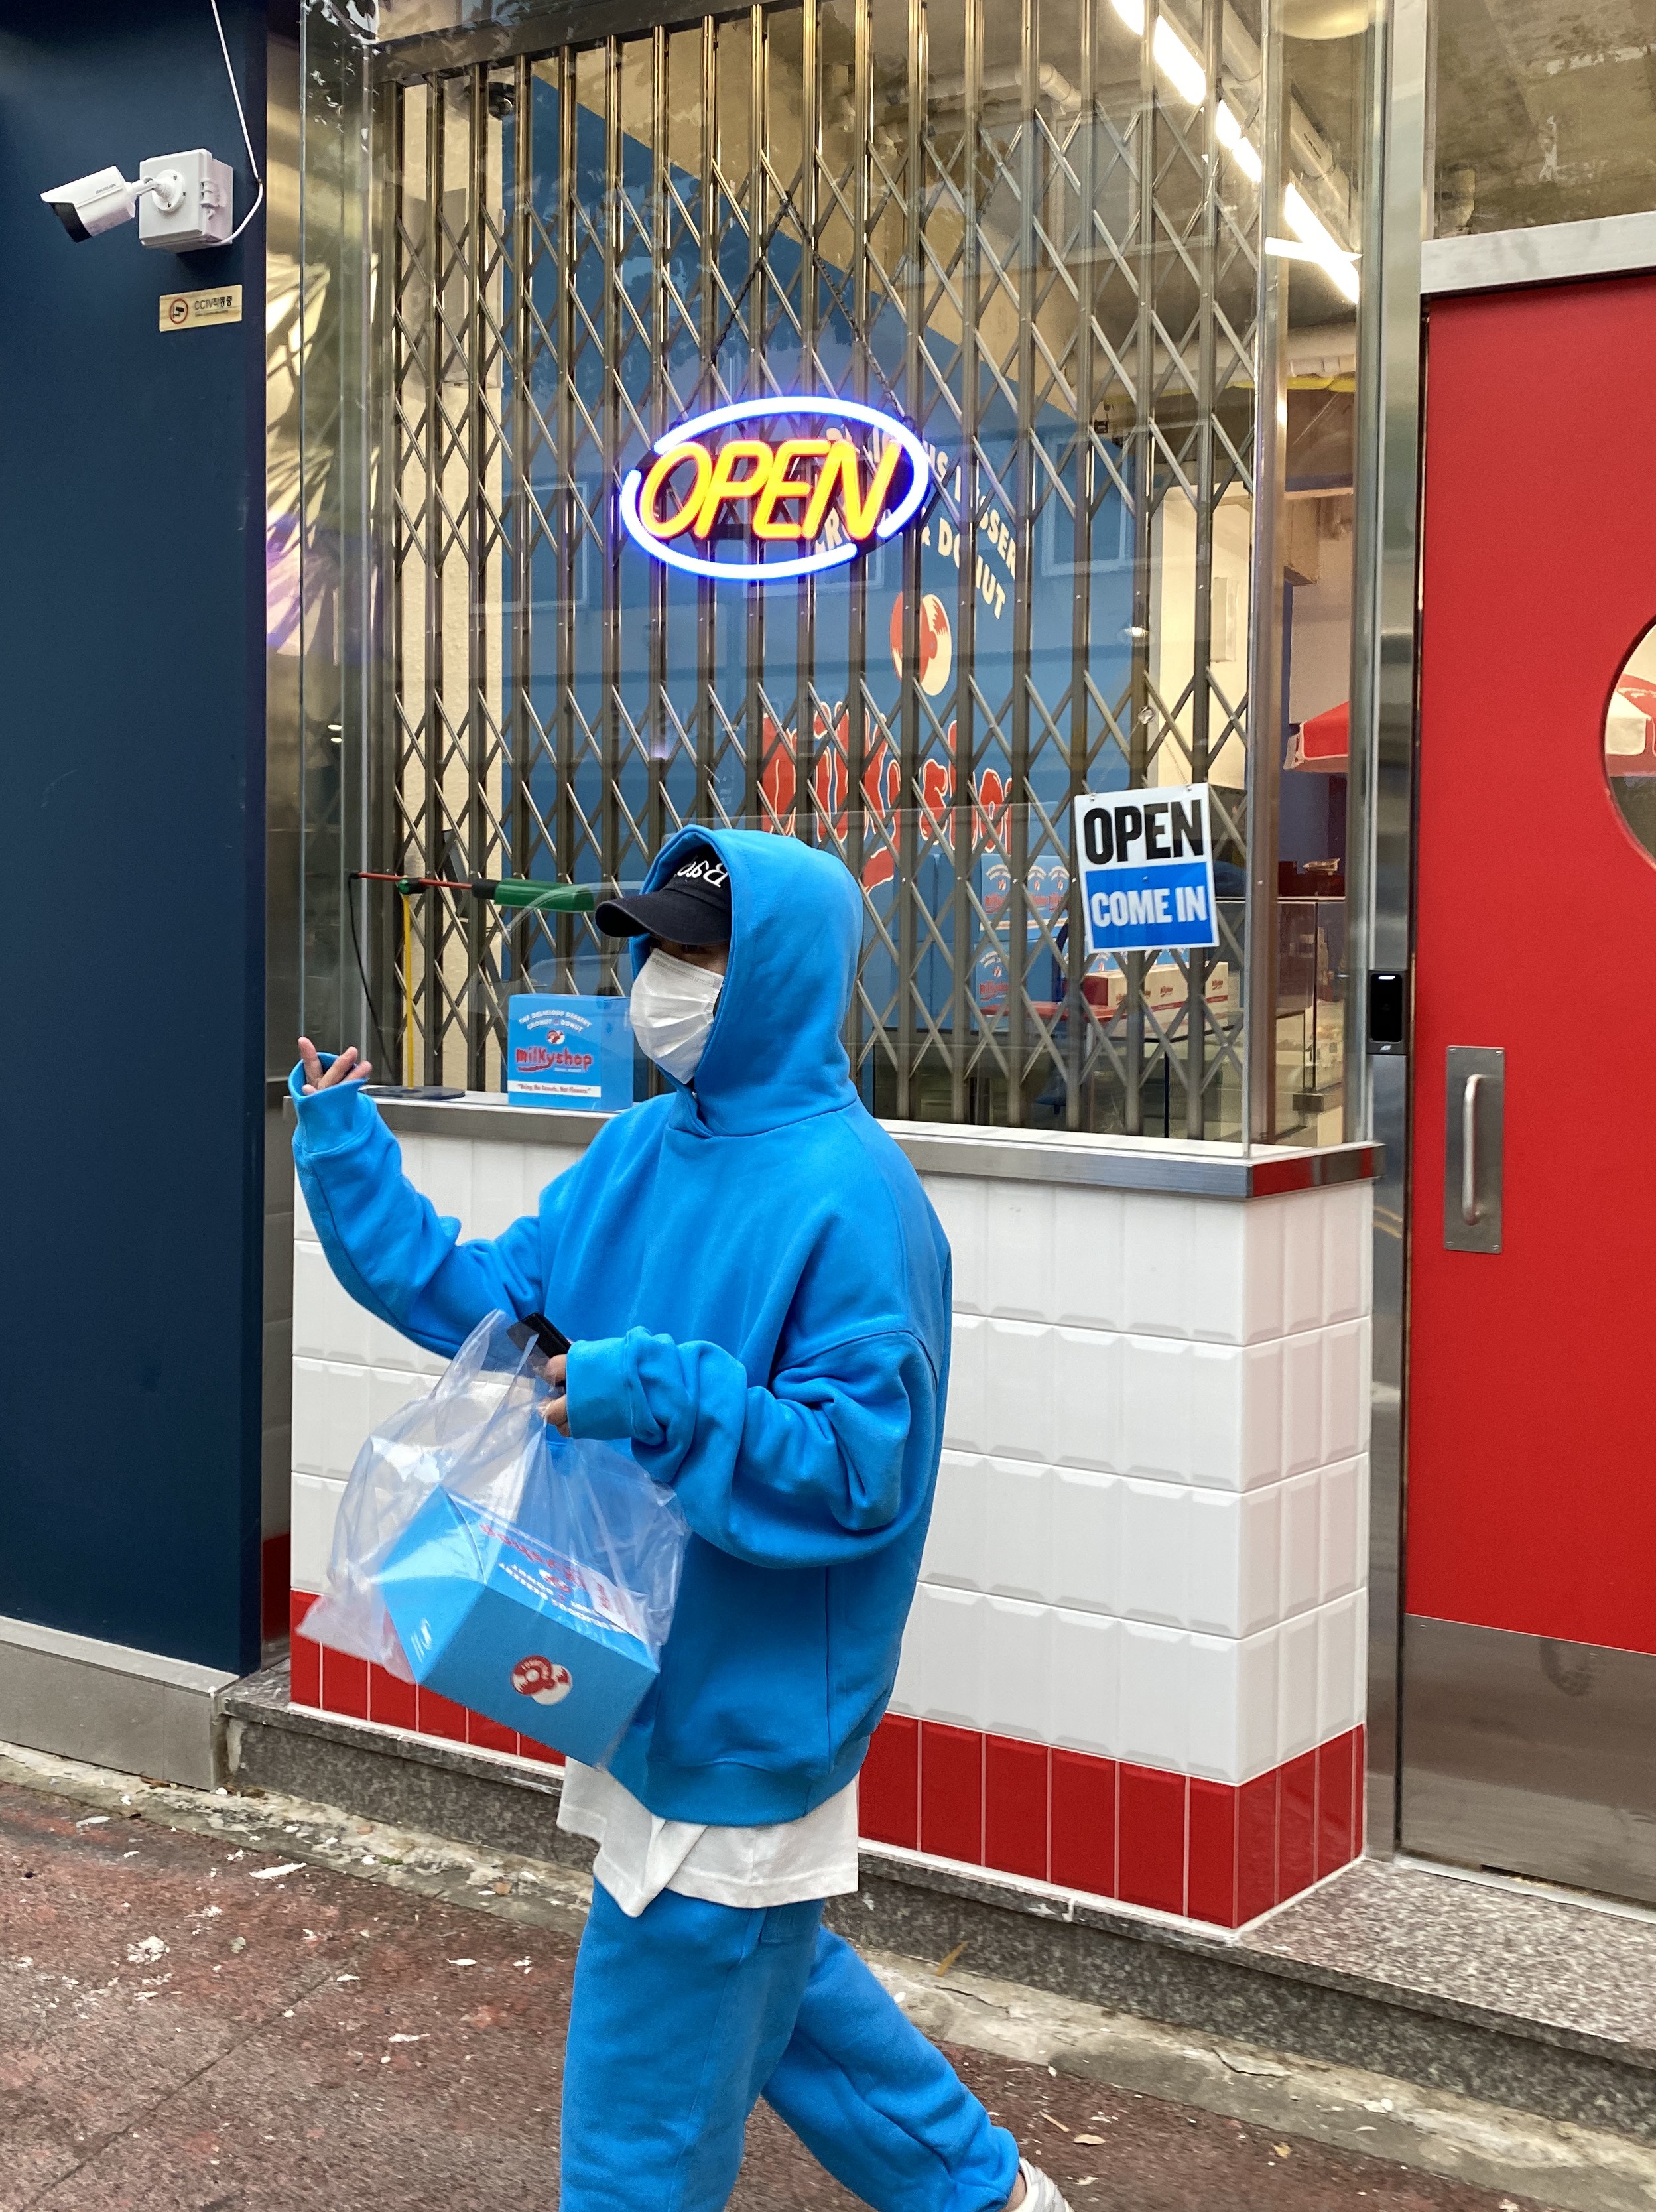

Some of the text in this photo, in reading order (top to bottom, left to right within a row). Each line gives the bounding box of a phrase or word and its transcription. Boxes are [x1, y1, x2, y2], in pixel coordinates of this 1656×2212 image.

[639, 439, 902, 541] OPEN
[1084, 799, 1204, 865] OPEN
[1090, 887, 1173, 928] COME
[1175, 885, 1208, 923] IN
[566, 1011, 592, 1027] DESSERT
